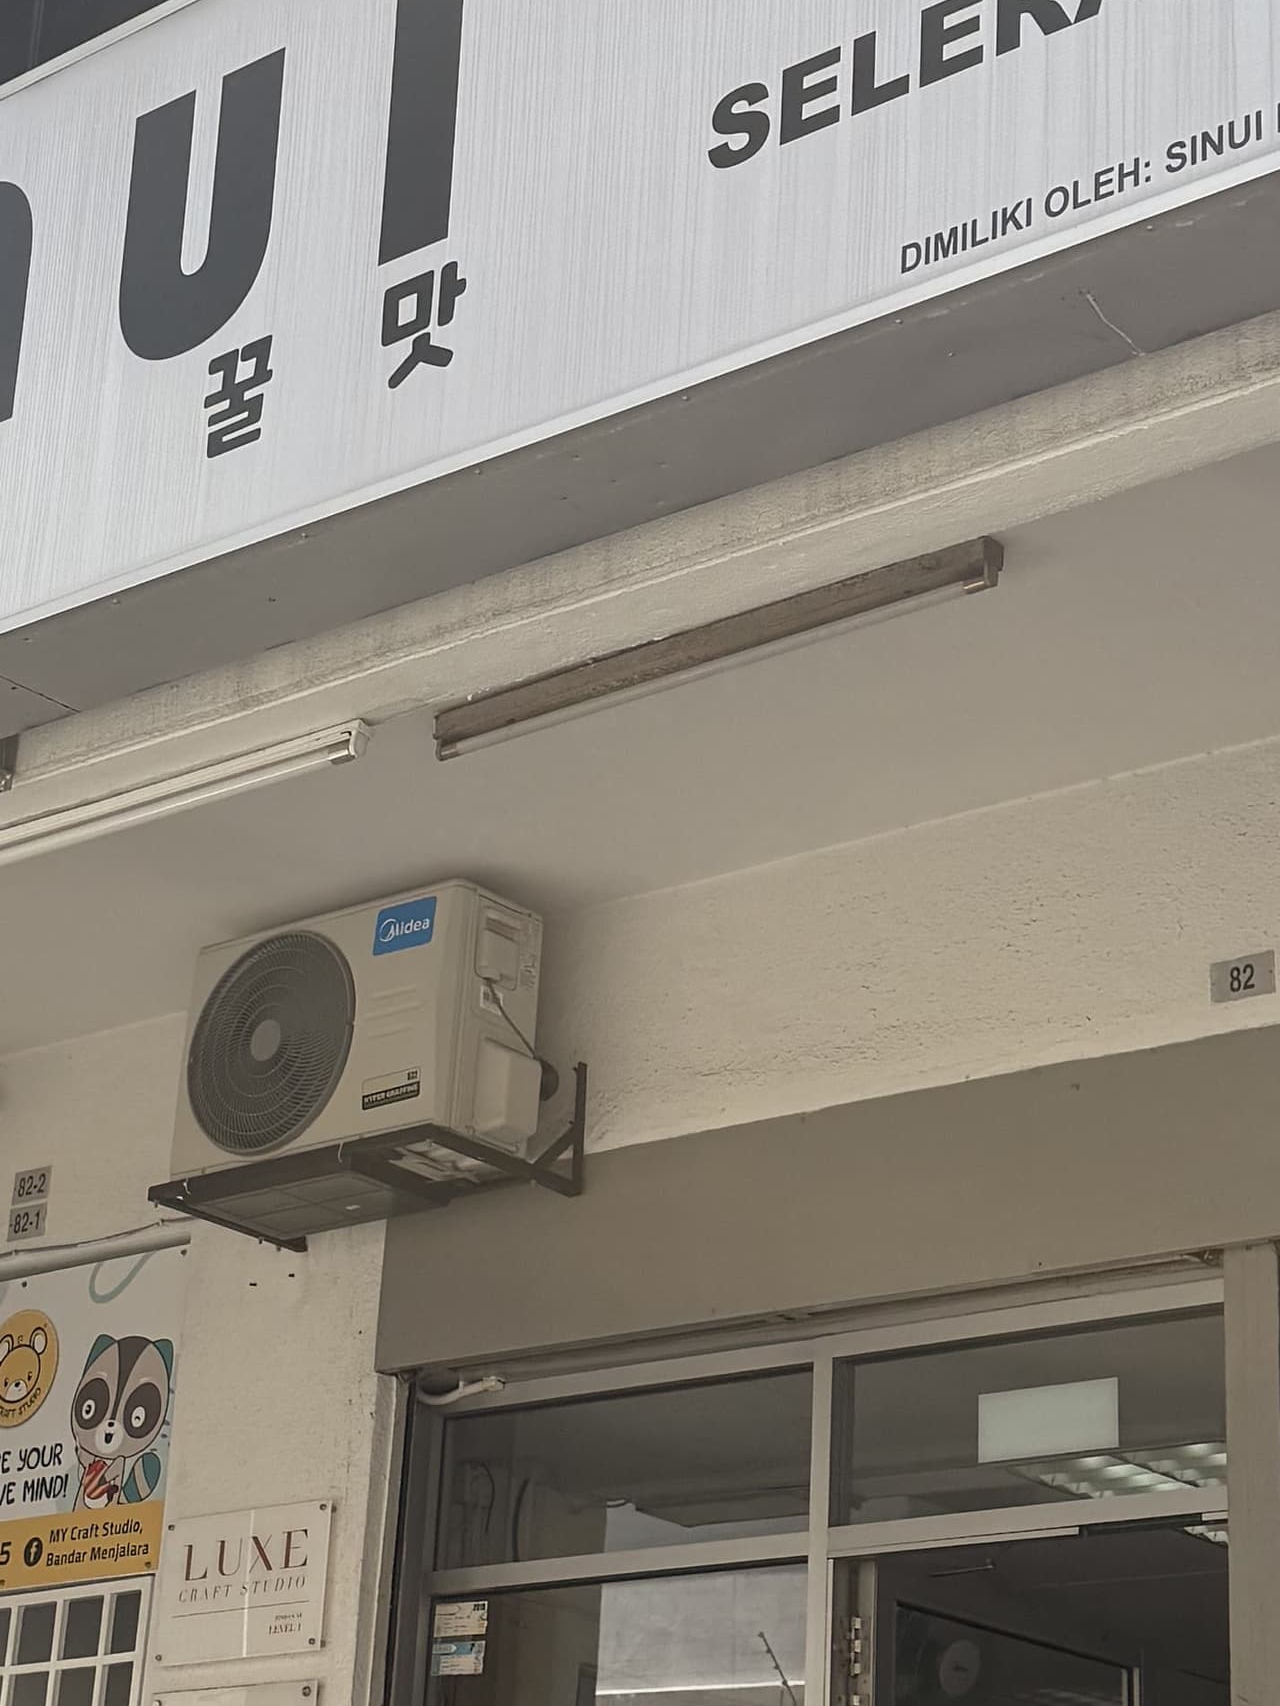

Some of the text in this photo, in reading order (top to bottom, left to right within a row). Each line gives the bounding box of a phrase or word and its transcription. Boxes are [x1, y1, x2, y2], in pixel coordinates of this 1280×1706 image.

[900, 198, 1033, 274] DIMILIKI
[1044, 156, 1152, 218] OLEH:
[1165, 110, 1262, 175] SINUI
[204, 260, 467, 458] 꿀 맛
[379, 915, 431, 942] Midea
[1230, 964, 1255, 992] 82
[17, 1171, 47, 1199] 82-2
[12, 1212, 42, 1235] 82-1
[17, 1443, 63, 1471] YOUR
[22, 1473, 68, 1501] MIND!
[49, 1520, 143, 1545] MY Craft Studio,
[46, 1540, 149, 1568] Bandar Menjalara
[183, 1528, 309, 1582] LUXE
[178, 1574, 307, 1605] CRAFT STUDIO
